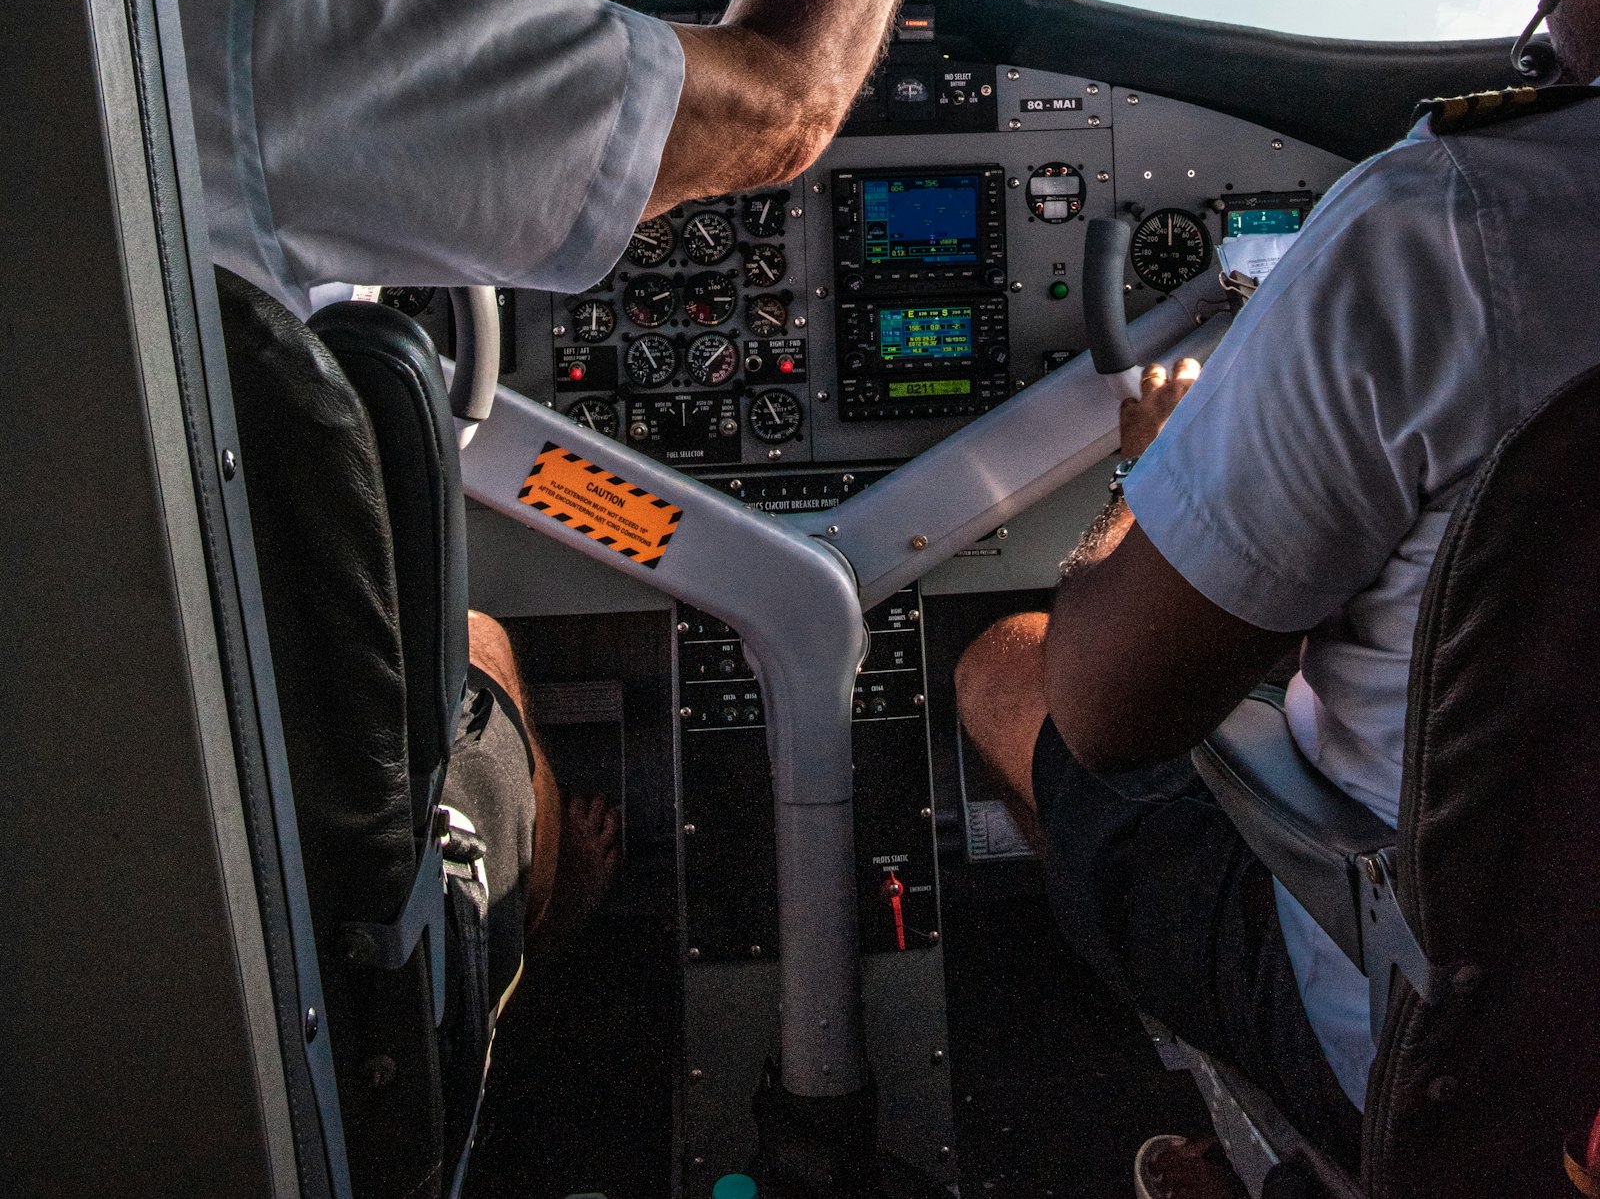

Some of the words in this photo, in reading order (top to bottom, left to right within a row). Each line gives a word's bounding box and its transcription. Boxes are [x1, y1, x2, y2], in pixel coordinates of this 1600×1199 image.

[1027, 100, 1043, 110] 8Q
[1053, 100, 1076, 109] MAI
[564, 347, 576, 355] LEFT
[680, 450, 704, 458] SELECTOR
[586, 482, 626, 508] CAUTION
[551, 481, 564, 490] FLAP
[564, 488, 592, 505] EXTENSION
[591, 501, 607, 513] MUST
[607, 510, 618, 519] NOT
[618, 515, 638, 530] EXCEED
[765, 500, 790, 510] CIRCUIT
[791, 499, 820, 509] BREAKER
[821, 498, 839, 507] PANEL
[539, 485, 555, 497] AFTER
[555, 493, 594, 518] ENCOUNTERING
[594, 515, 605, 524] ANY
[606, 521, 620, 531] ICING
[620, 527, 652, 547] CONDITIONS
[891, 854, 908, 863] STATIC
